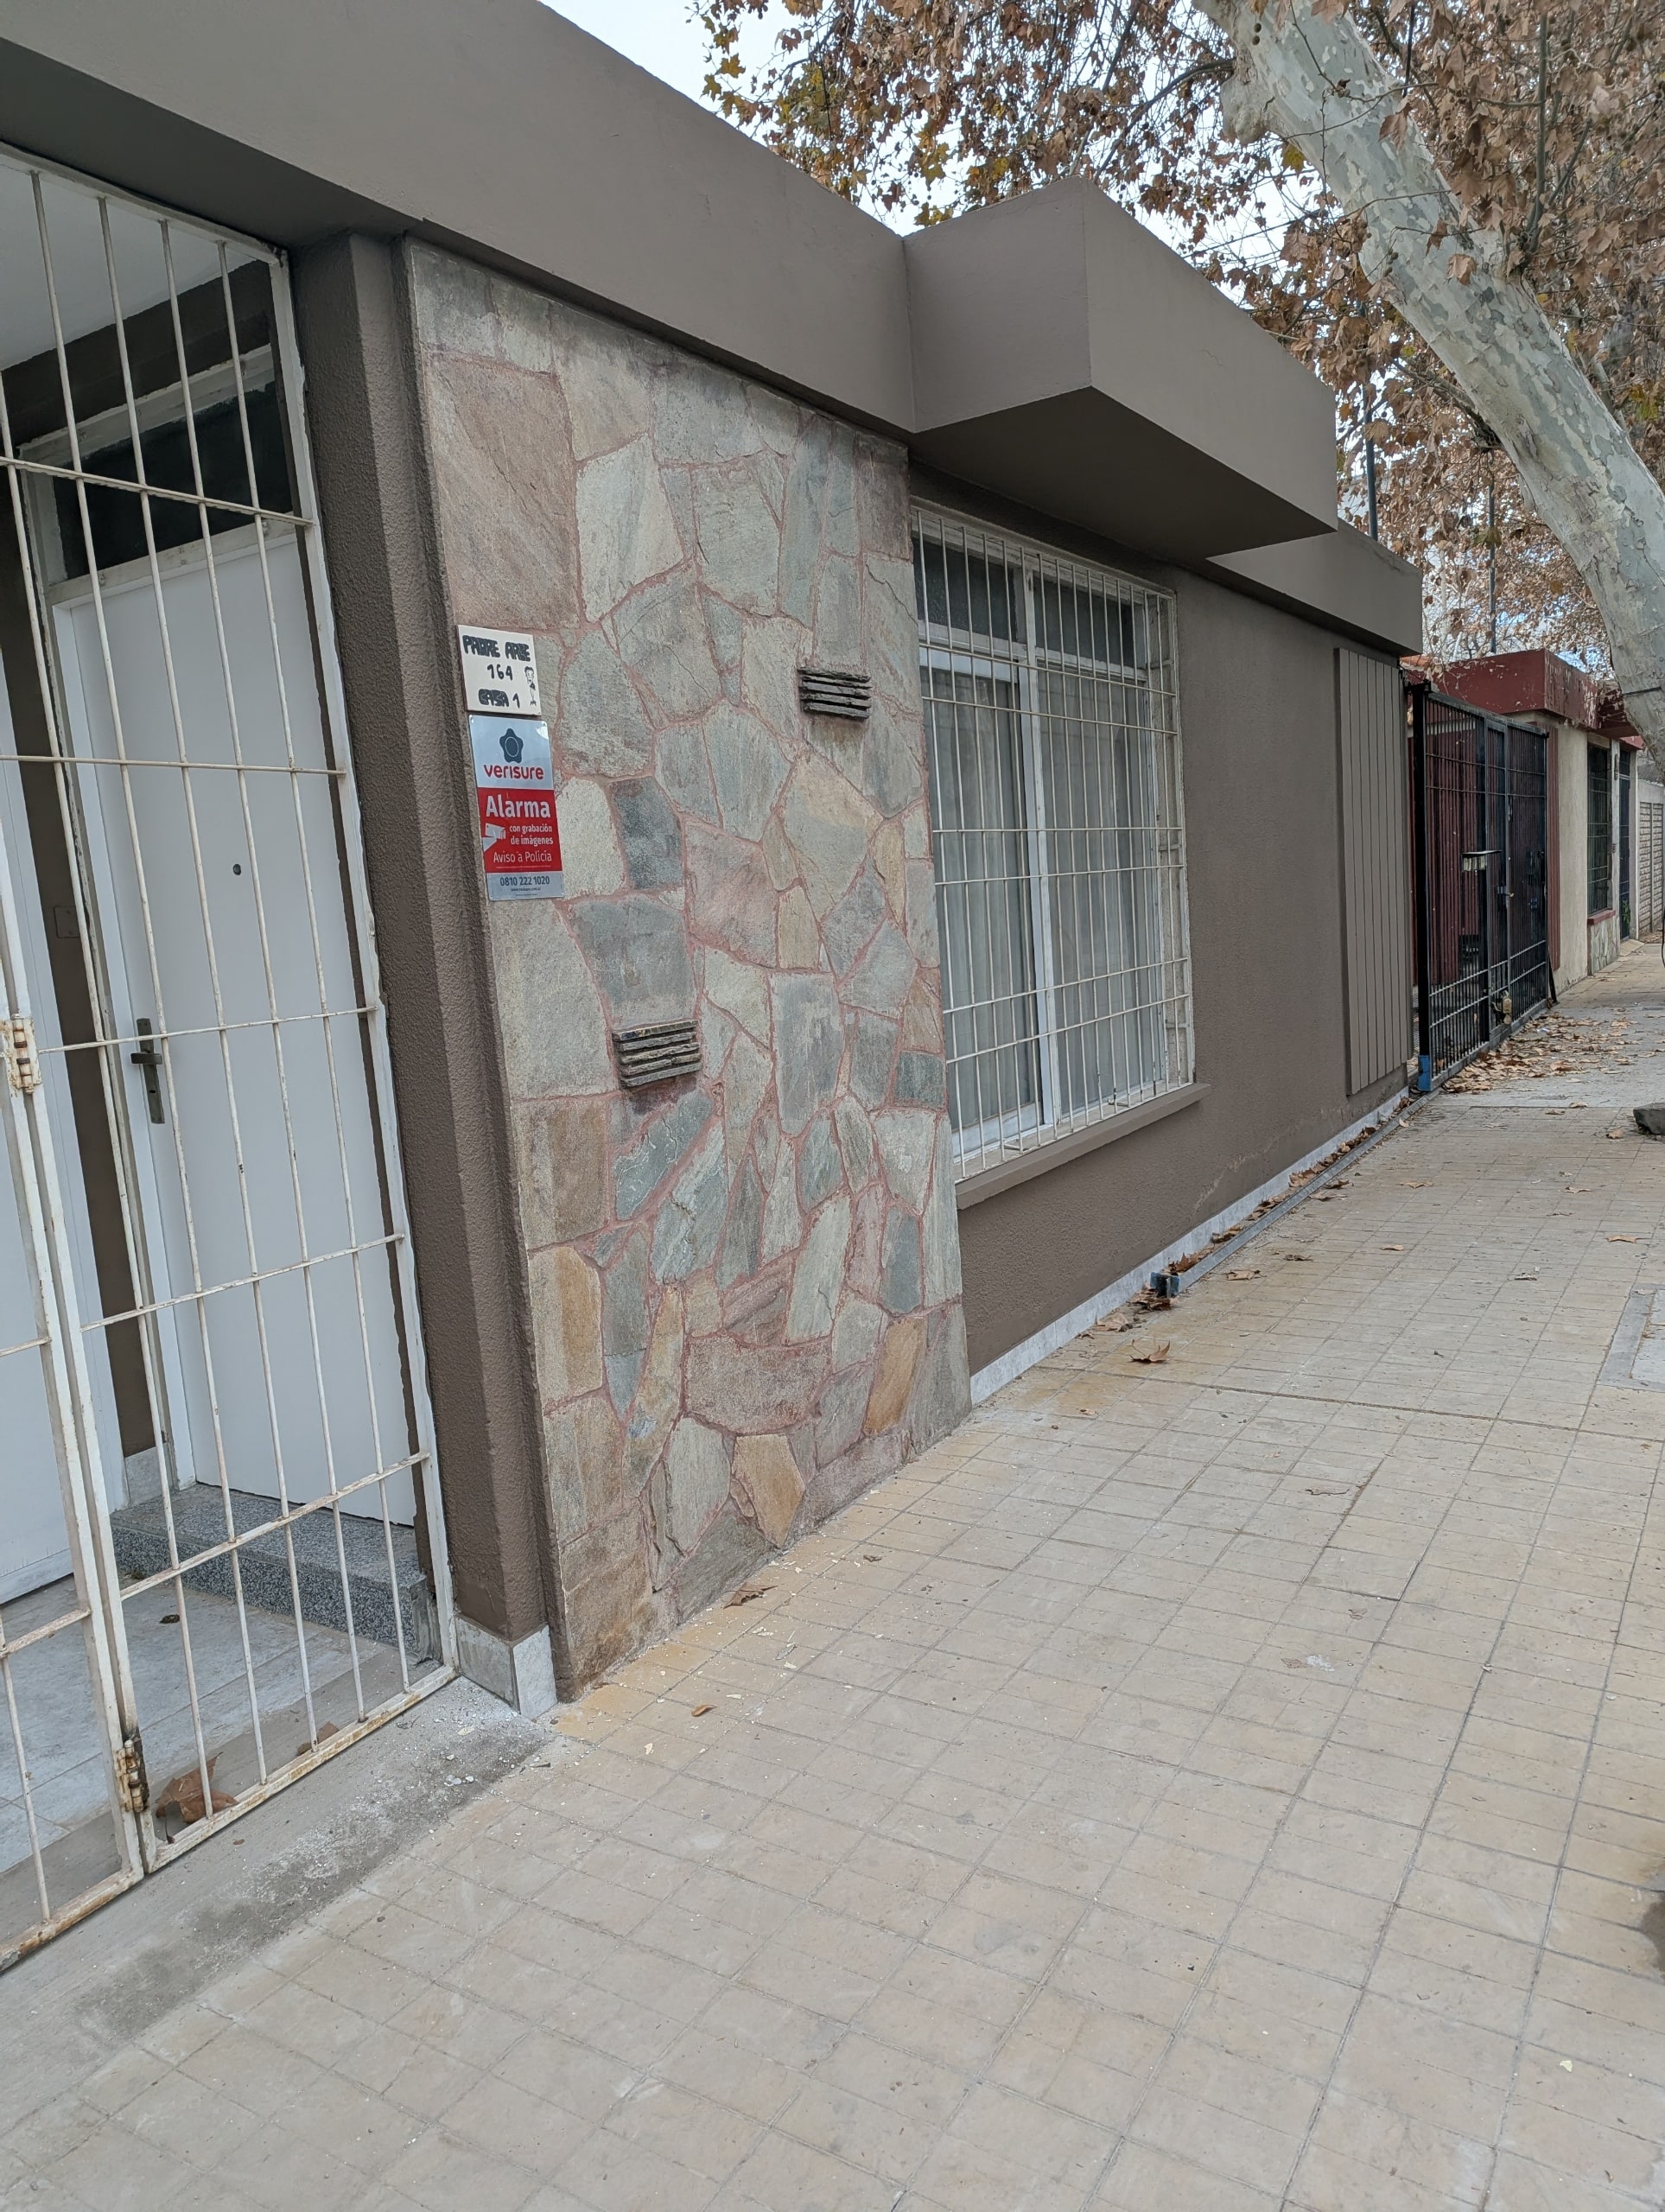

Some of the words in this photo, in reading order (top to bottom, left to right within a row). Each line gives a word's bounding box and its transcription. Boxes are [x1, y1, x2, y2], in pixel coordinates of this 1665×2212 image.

[462, 635, 501, 658] PADRE
[487, 664, 513, 681] 164
[479, 689, 509, 707] CASA
[512, 693, 520, 709] 1
[484, 765, 543, 780] verisure
[486, 794, 550, 818] Alarma
[522, 823, 552, 835] grabación
[511, 836, 519, 845] de
[520, 835, 554, 847] imágenes
[493, 851, 516, 863] Aviso
[518, 853, 523, 862] a
[524, 850, 552, 862] Policía
[499, 877, 518, 887] 0810
[519, 876, 532, 886] 222
[534, 875, 550, 885] 1020
